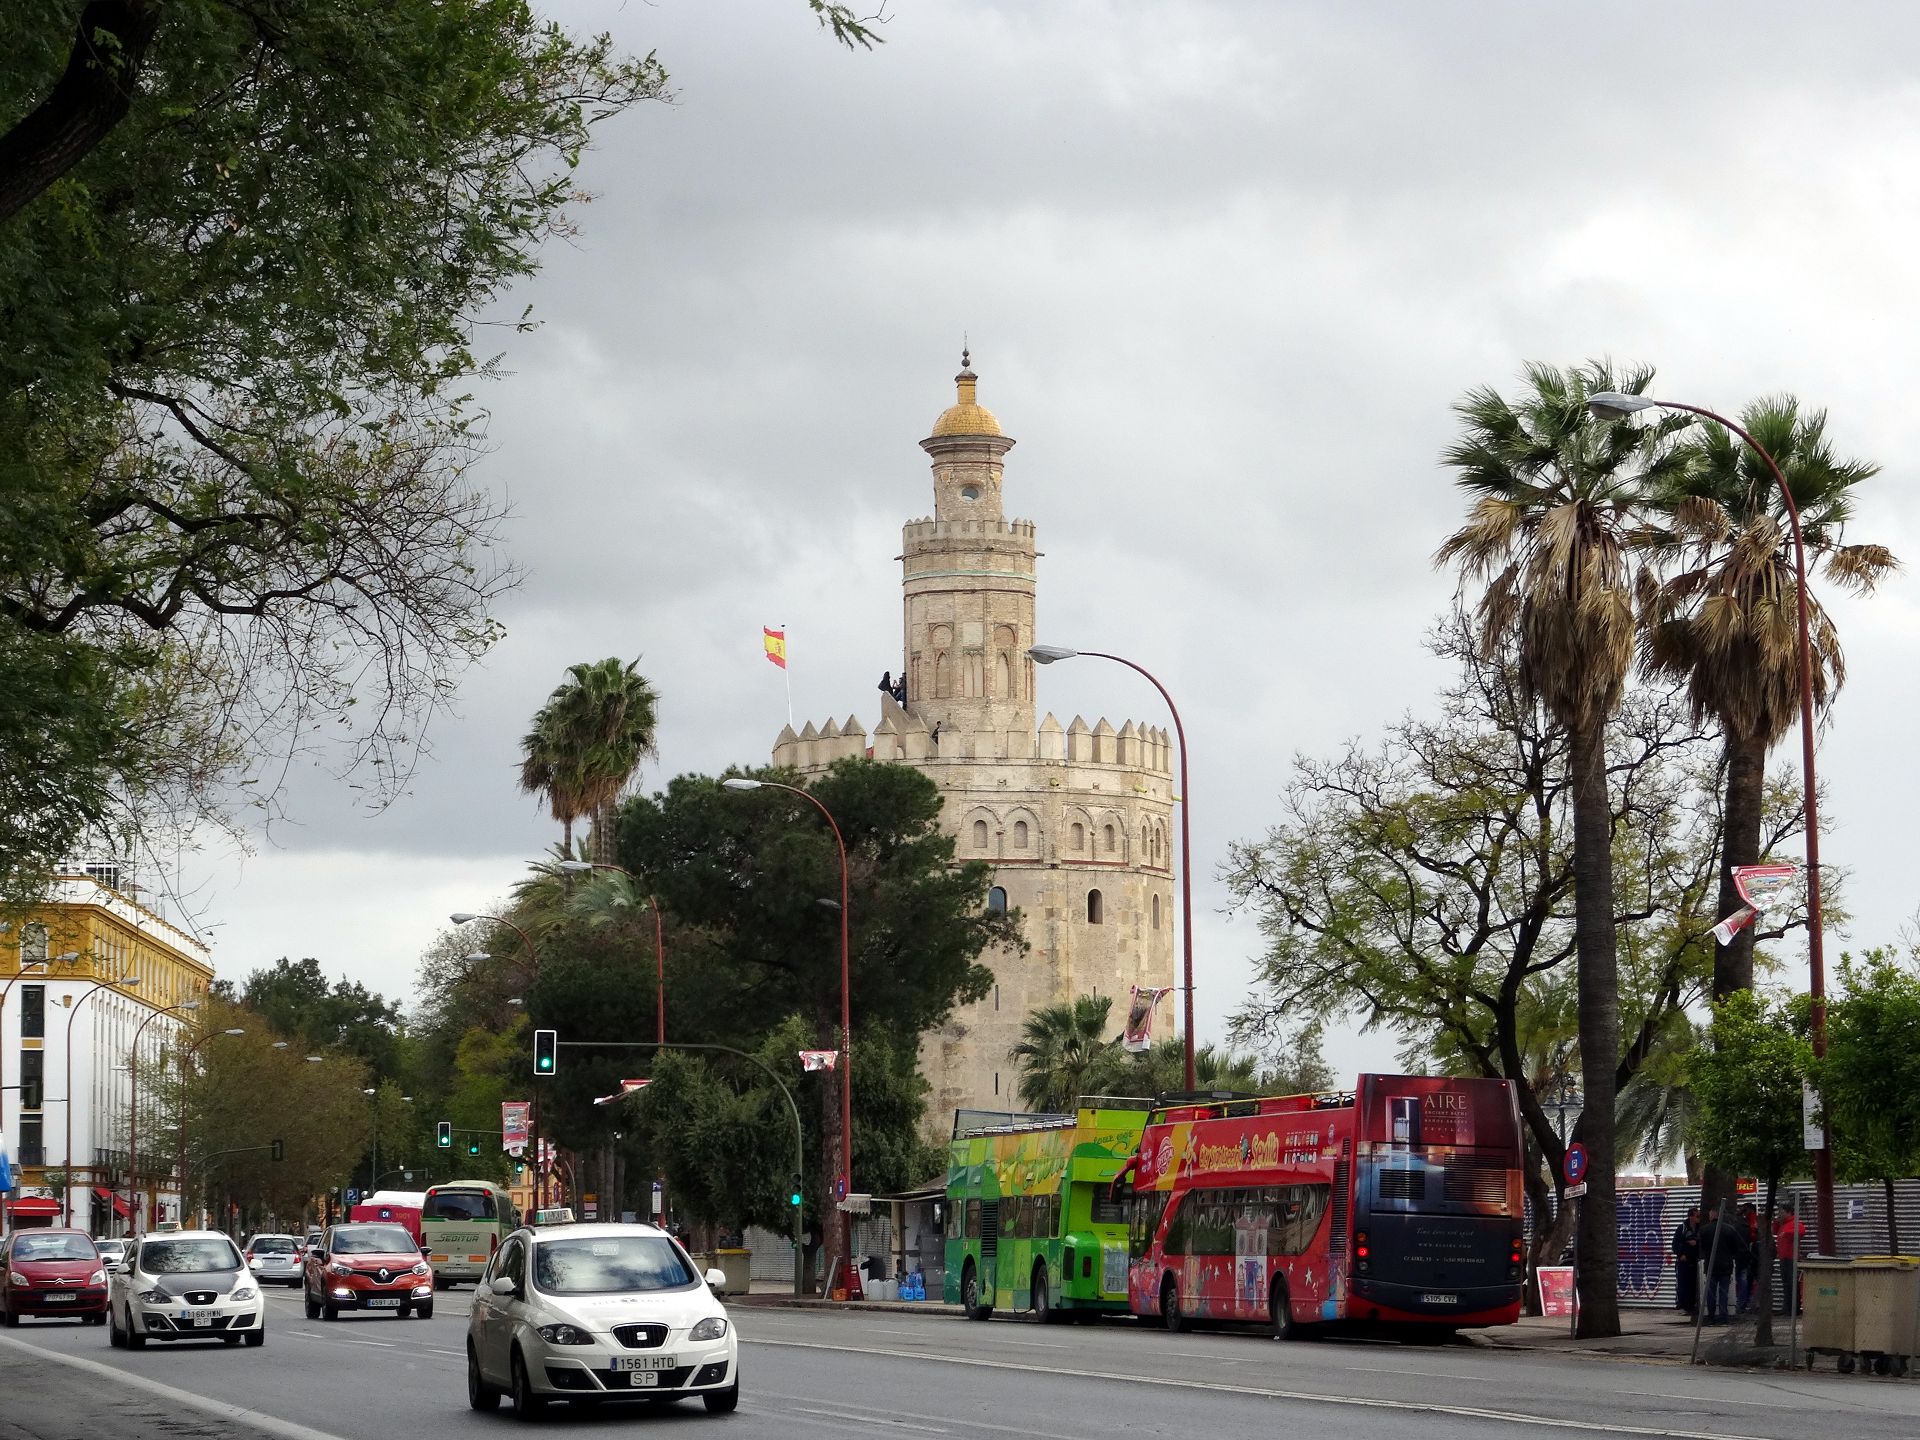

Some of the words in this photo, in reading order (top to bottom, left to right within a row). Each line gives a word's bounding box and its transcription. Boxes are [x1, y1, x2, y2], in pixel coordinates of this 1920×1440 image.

[1424, 1094, 1467, 1110] AIRE
[347, 1190, 354, 1199] P
[196, 1318, 209, 1326] SP
[621, 1358, 648, 1370] 1561
[652, 1357, 674, 1369] HTD
[633, 1373, 655, 1385] SP
